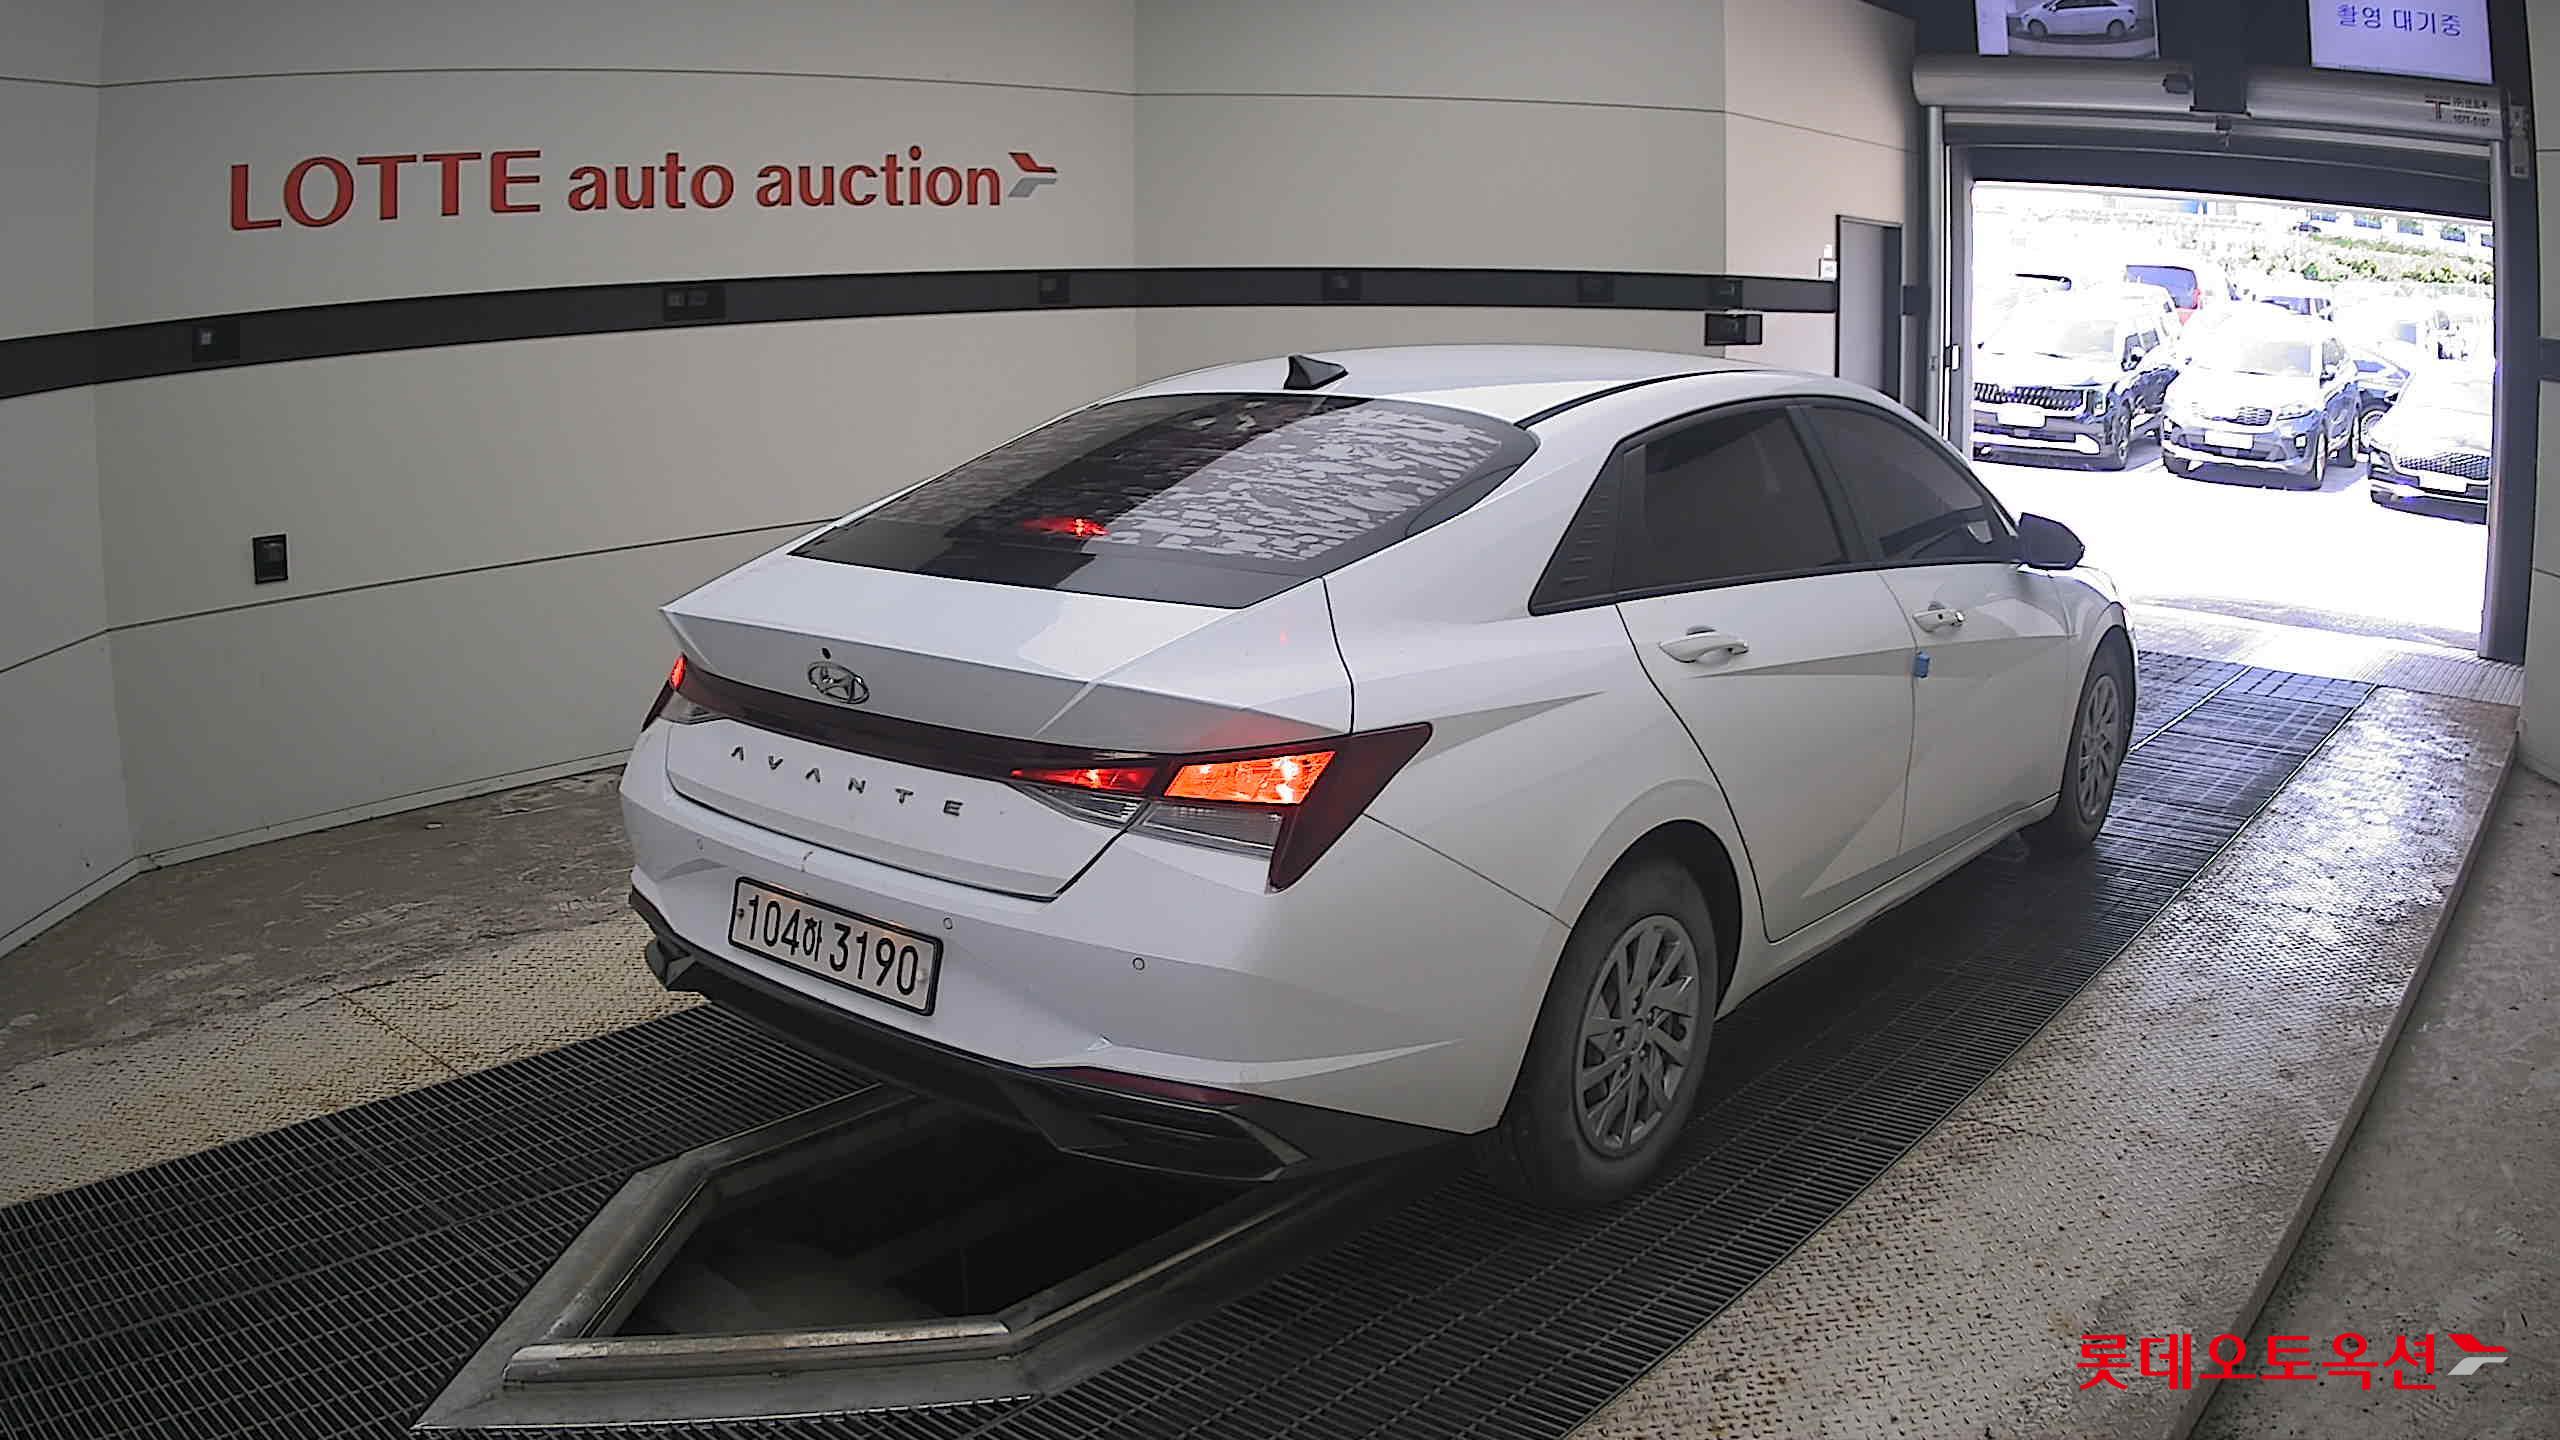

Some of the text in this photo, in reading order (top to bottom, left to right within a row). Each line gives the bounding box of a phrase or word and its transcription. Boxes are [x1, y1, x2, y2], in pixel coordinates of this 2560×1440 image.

[2338, 4, 2461, 37] 촬영 대기중
[231, 146, 1001, 231] LOTTE auto auction
[731, 746, 964, 816] AVANTE
[829, 922, 919, 996] 3190
